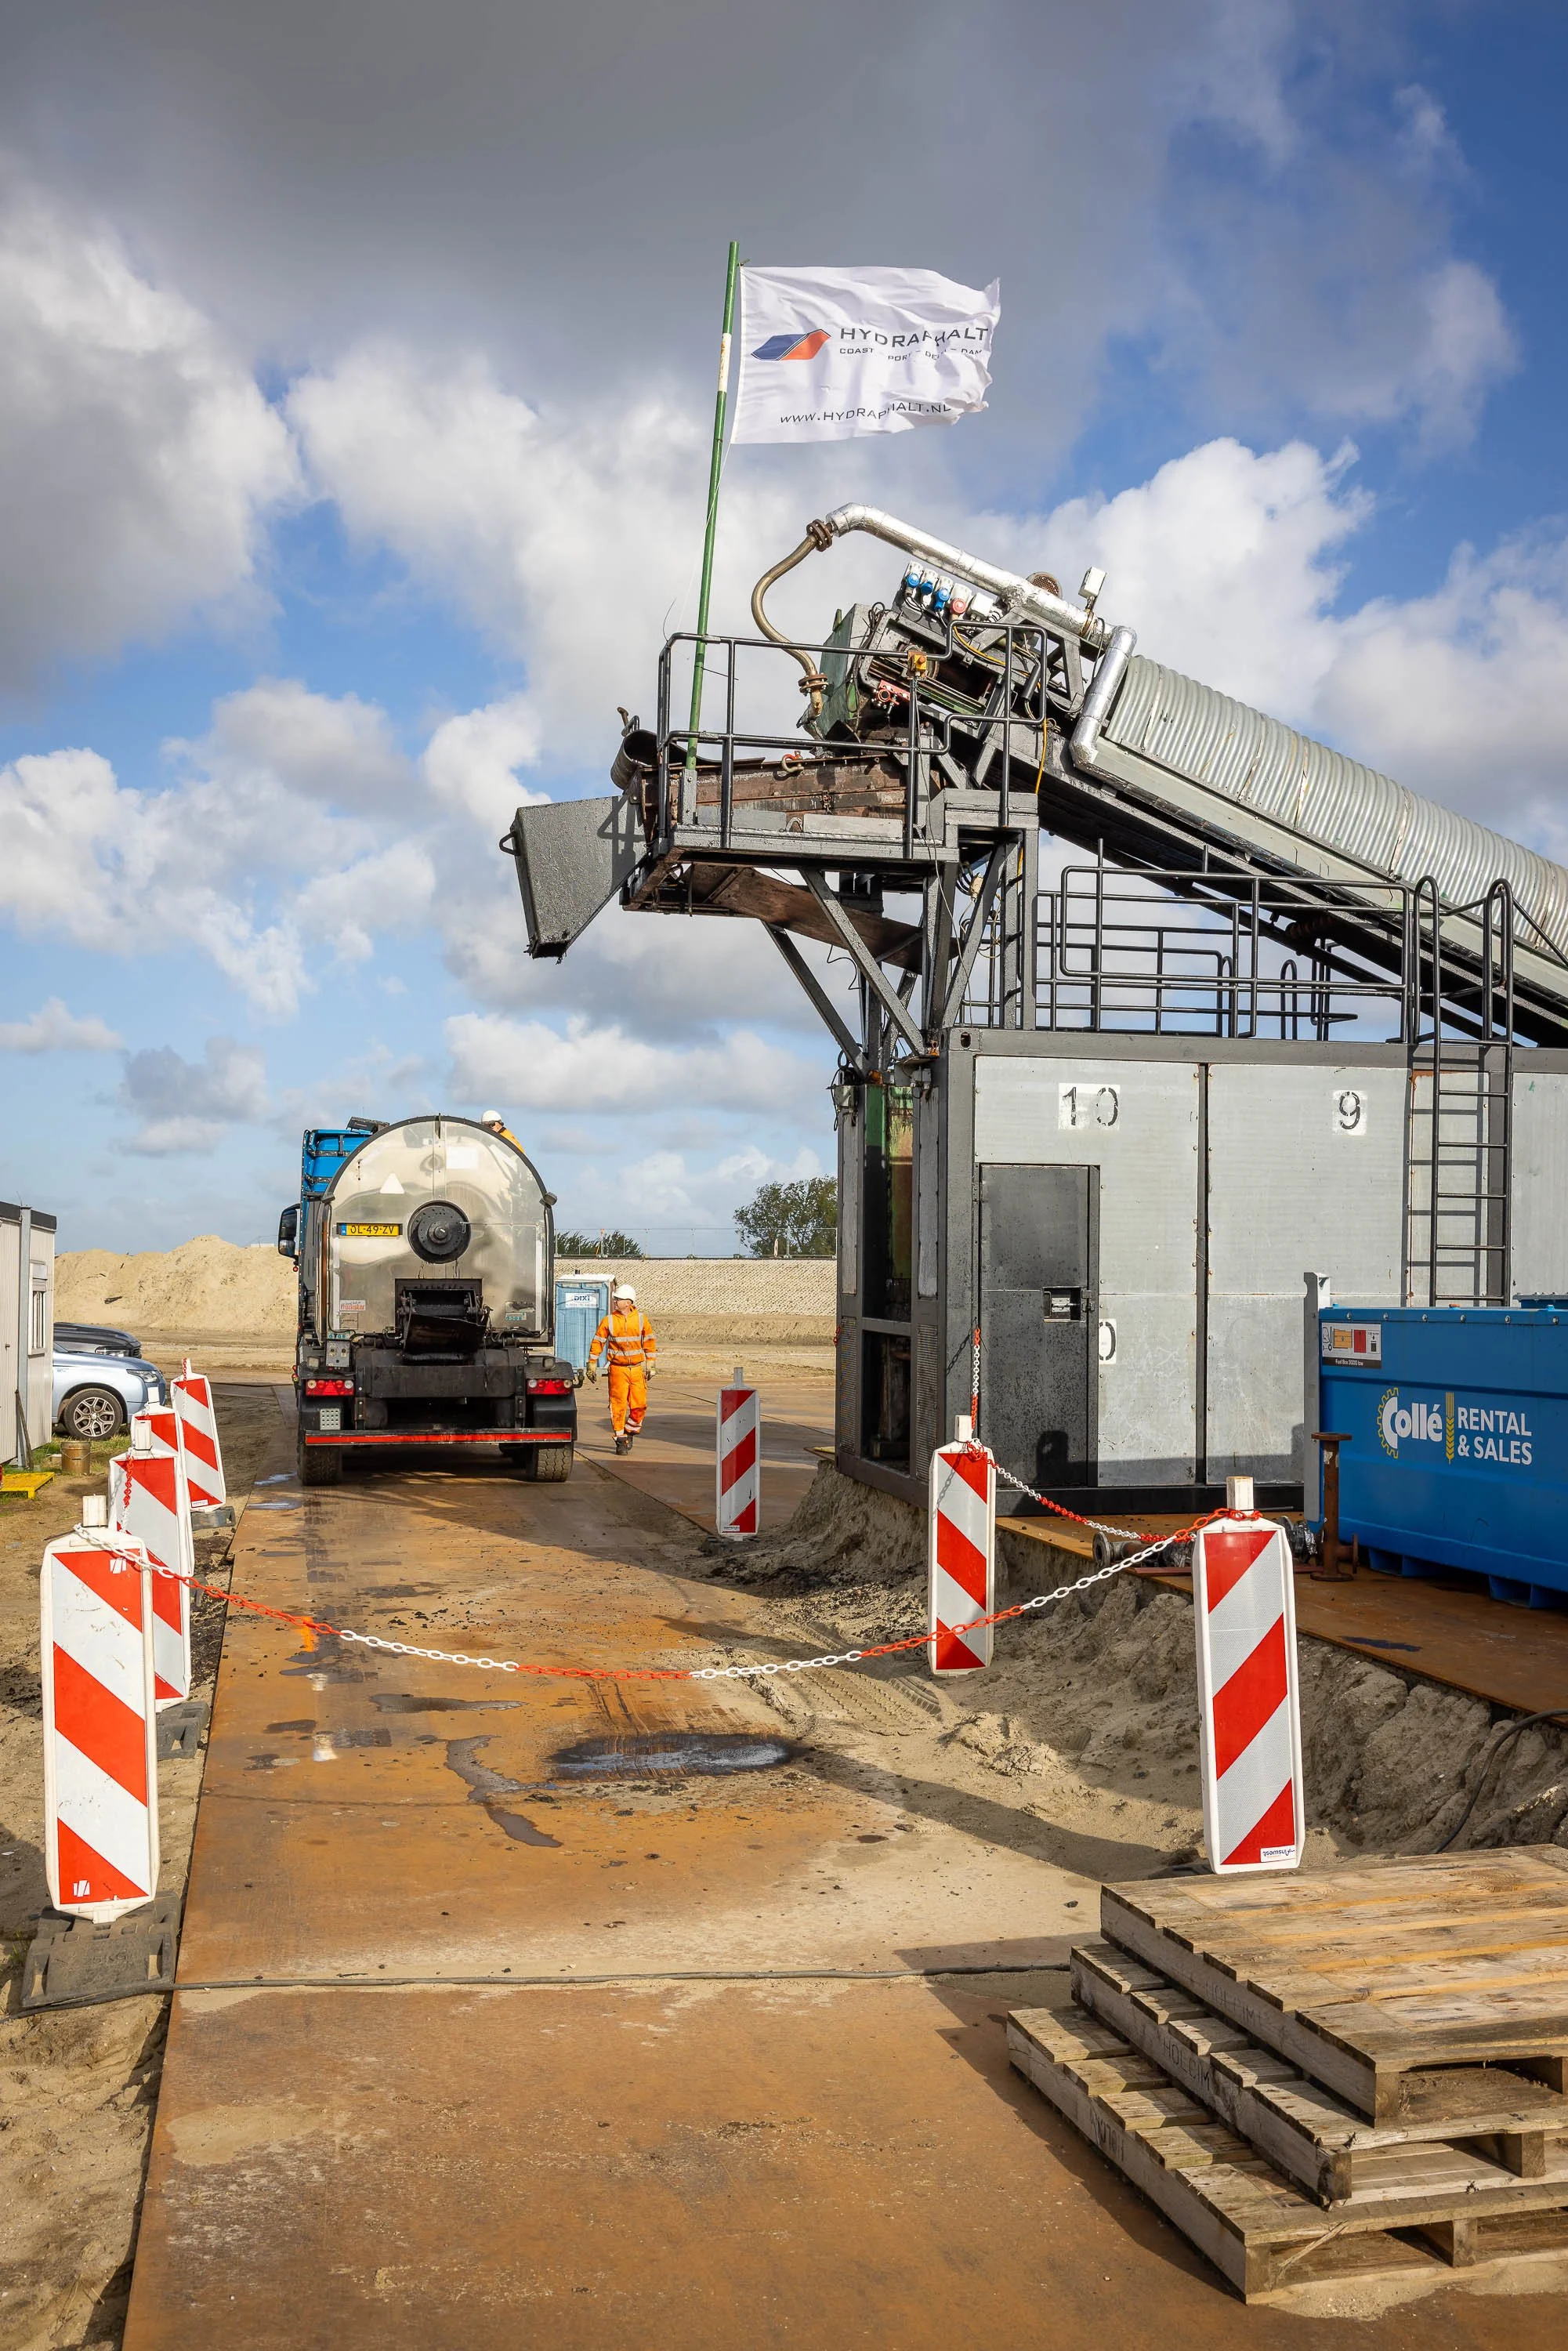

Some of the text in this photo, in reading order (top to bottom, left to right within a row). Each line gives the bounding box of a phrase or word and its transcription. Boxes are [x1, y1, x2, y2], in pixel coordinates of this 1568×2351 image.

[1063, 1086, 1118, 1126] 10
[1339, 1091, 1360, 1129] 9
[1382, 1396, 1443, 1449] Collé
[1458, 1407, 1532, 1436] RENTAL
[1458, 1434, 1533, 1465] & SALES
[1163, 2036, 1210, 2092] HOLCIM
